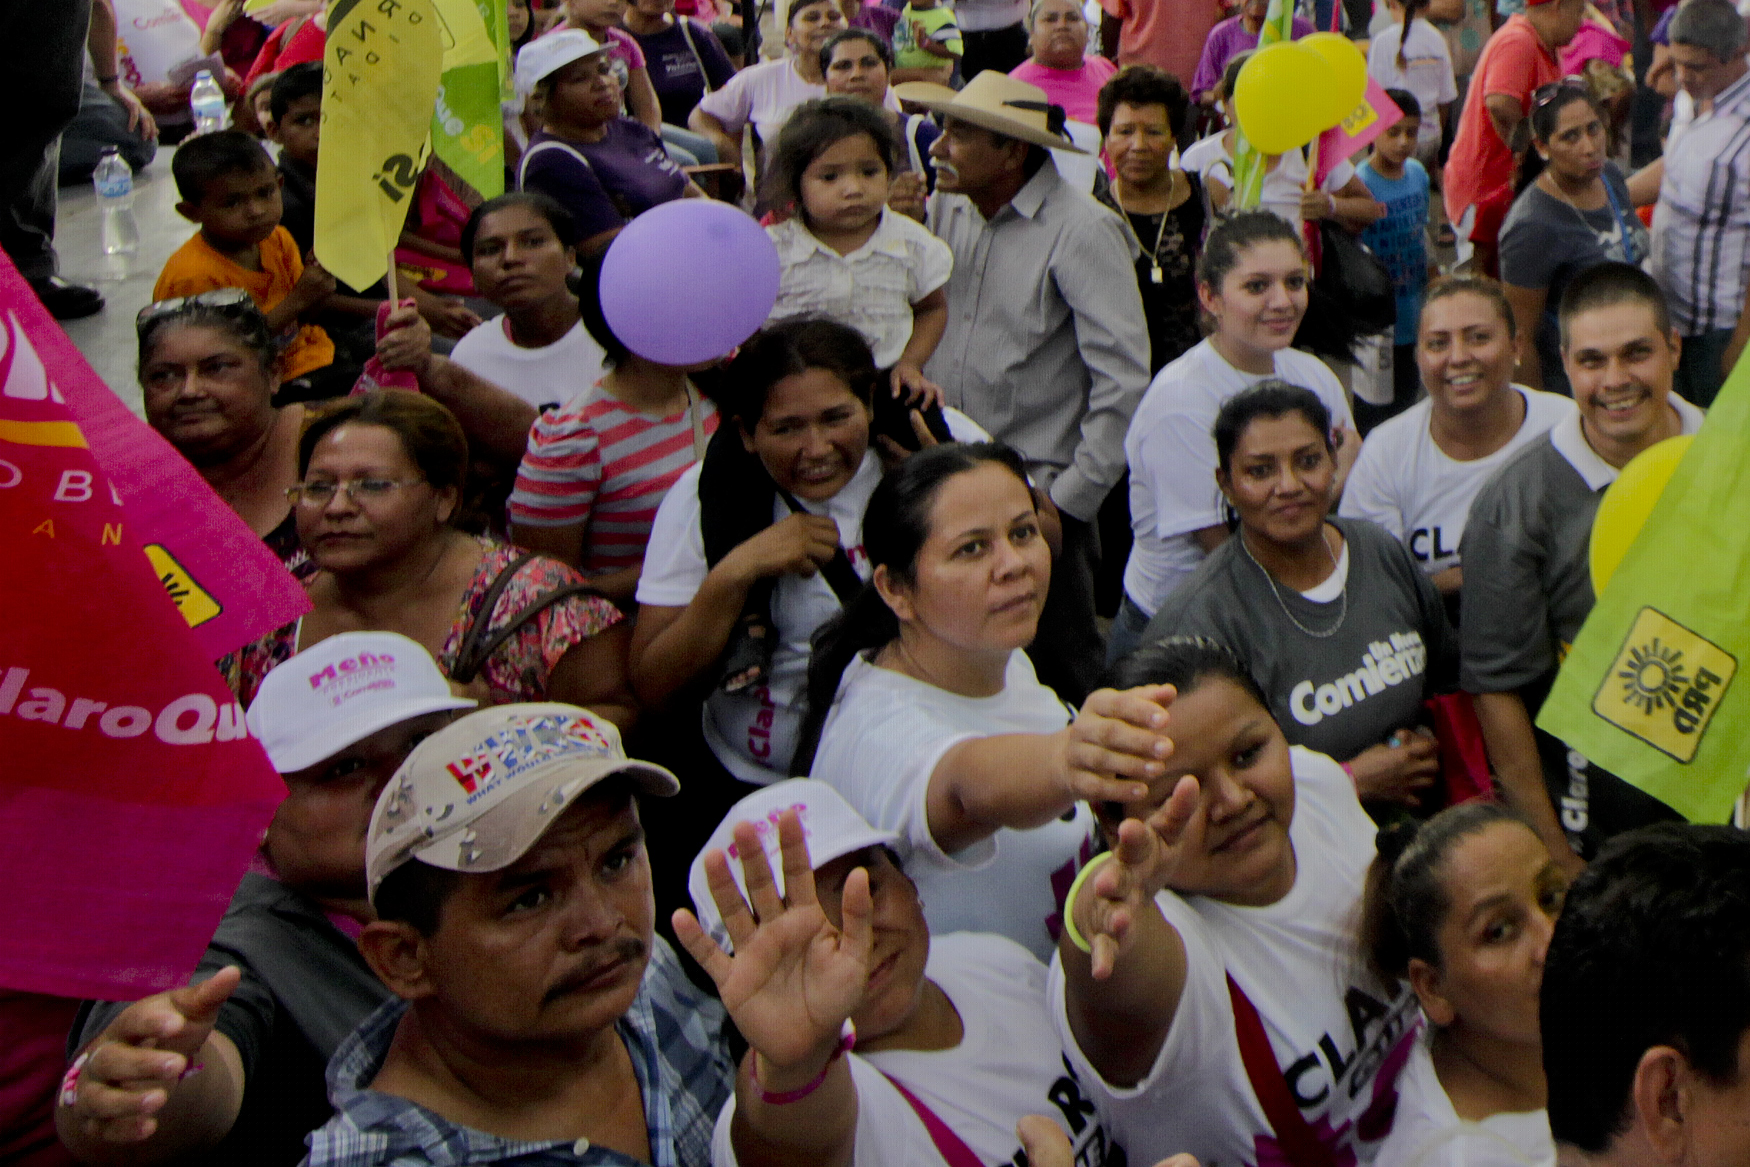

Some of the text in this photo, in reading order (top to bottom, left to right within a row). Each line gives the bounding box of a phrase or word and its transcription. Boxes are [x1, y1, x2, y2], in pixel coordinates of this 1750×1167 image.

[1411, 526, 1461, 561] CL
[0, 666, 248, 746] laroQu
[1289, 645, 1427, 725] Comienz
[1283, 982, 1397, 1109] CLA
